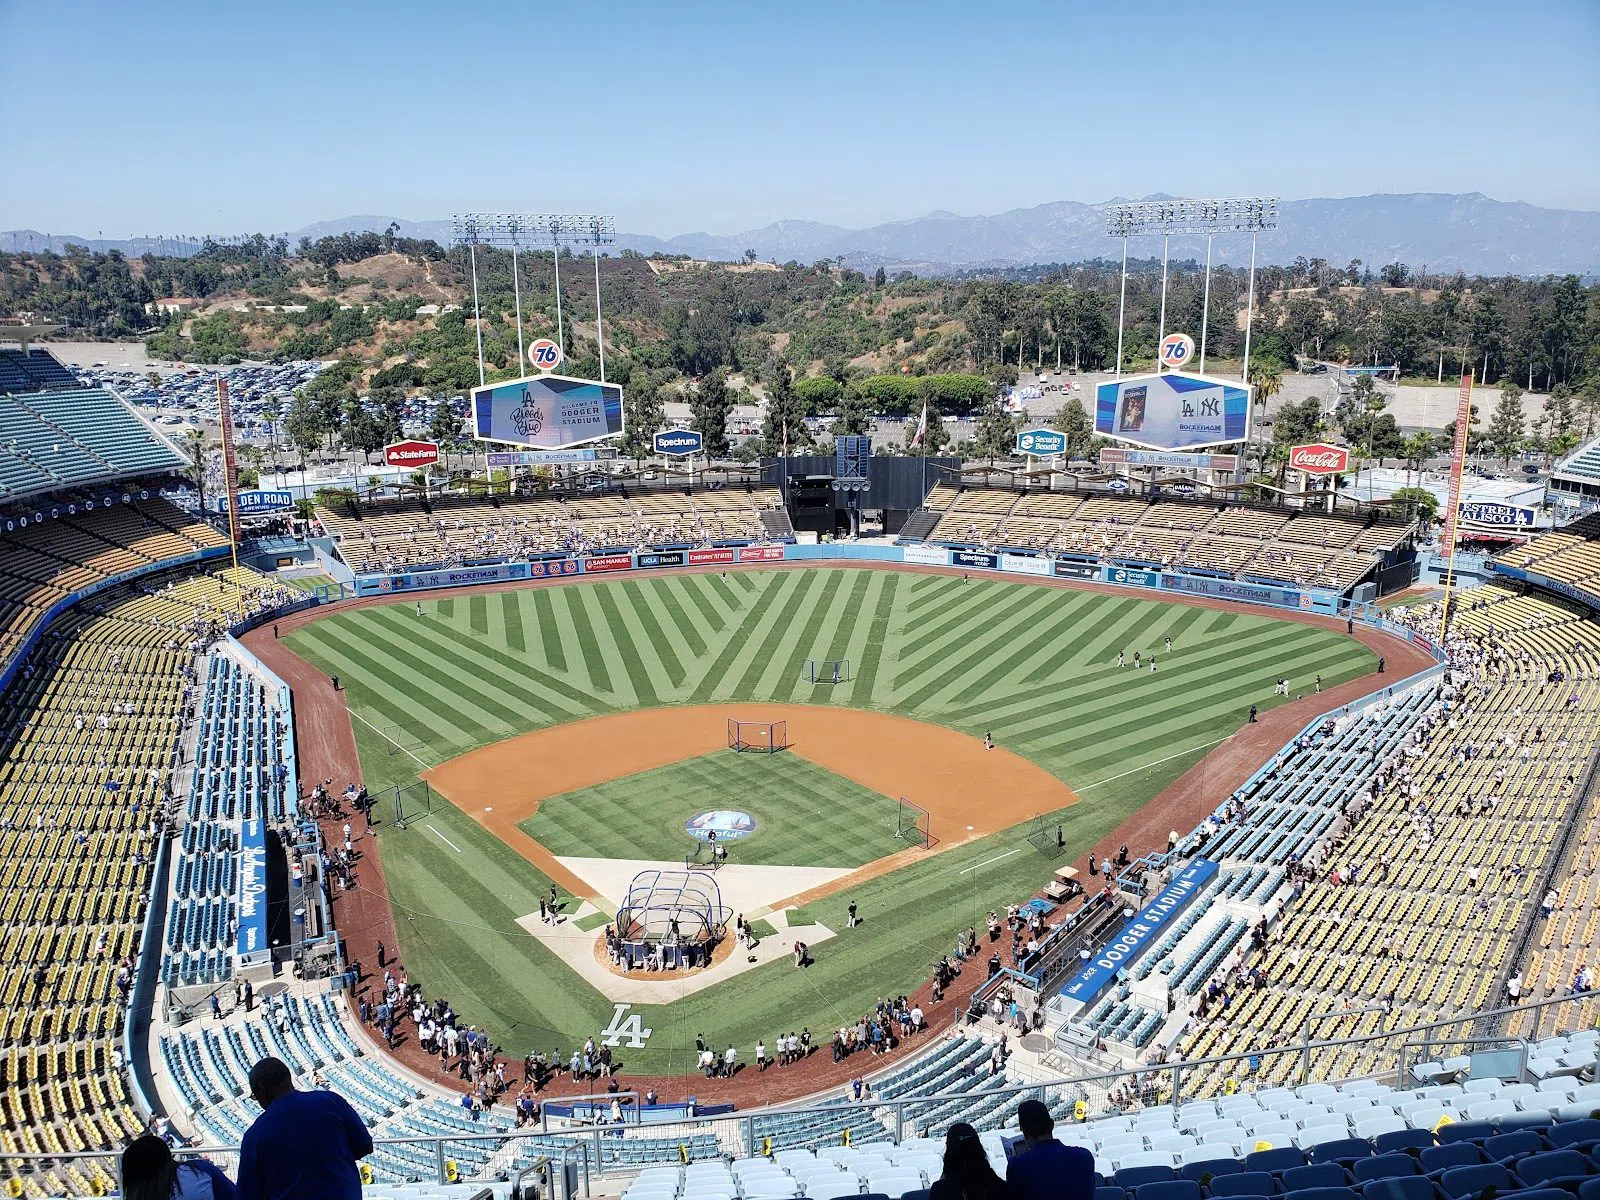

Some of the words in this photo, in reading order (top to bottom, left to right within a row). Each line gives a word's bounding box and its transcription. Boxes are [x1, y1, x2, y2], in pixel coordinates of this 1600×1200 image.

[535, 346, 557, 363] 76
[1164, 342, 1186, 360] 76
[521, 388, 535, 408] LA
[562, 407, 599, 417] DODGER
[1182, 399, 1194, 417] LA
[1201, 397, 1220, 416] NY
[510, 408, 544, 423] Bleeds
[562, 417, 601, 425] STADIUM
[514, 419, 542, 435] Blue
[658, 438, 696, 448] Spectrum
[1035, 436, 1062, 444] Security
[264, 493, 290, 505] ROAD
[1457, 510, 1511, 523] JALISCO
[960, 554, 988, 562] Spectrum
[449, 570, 498, 580] ROCKETMAN
[1127, 571, 1149, 580] Security
[1219, 584, 1271, 599] ROCKETMAN
[1545, 579, 1575, 596] WELCOME
[1144, 880, 1194, 922] STADIUM
[1097, 923, 1150, 970] DODGER
[600, 1003, 653, 1049] LA
